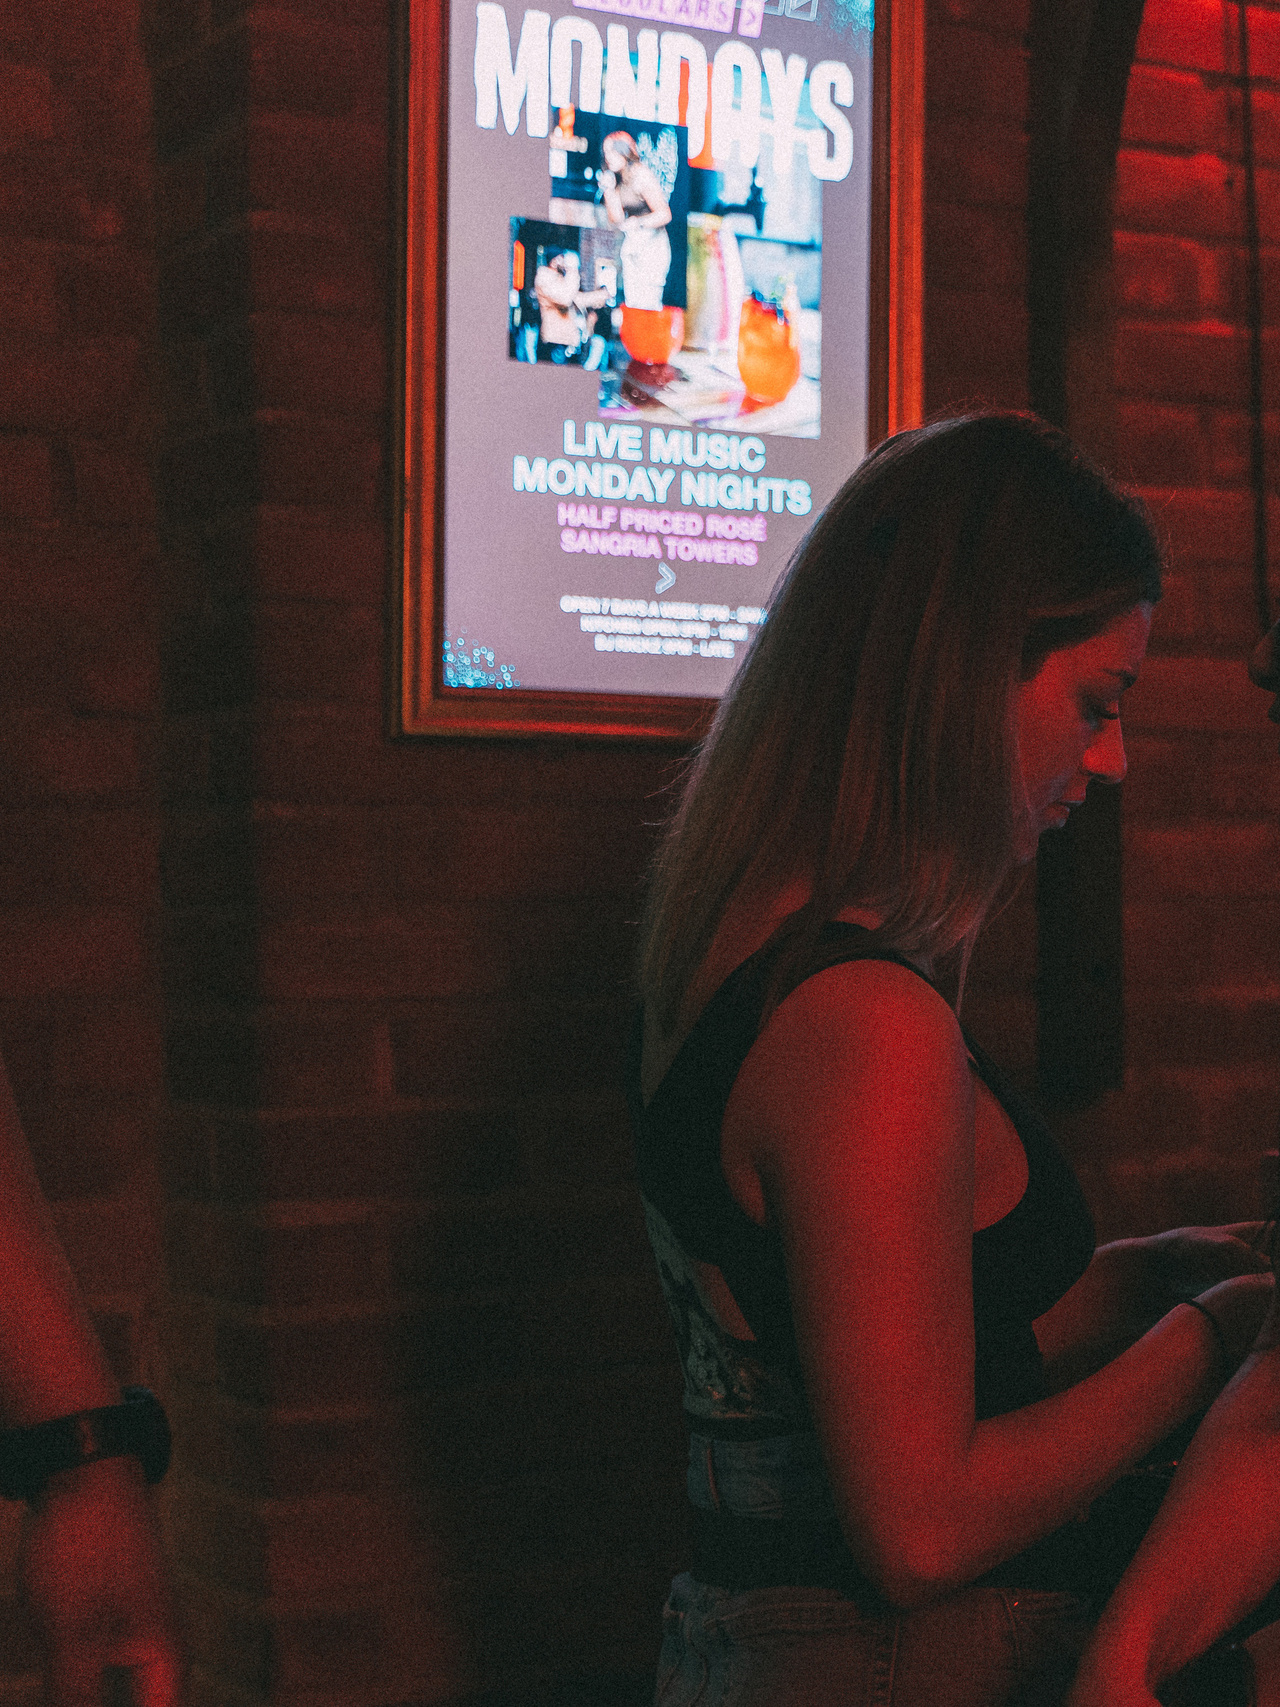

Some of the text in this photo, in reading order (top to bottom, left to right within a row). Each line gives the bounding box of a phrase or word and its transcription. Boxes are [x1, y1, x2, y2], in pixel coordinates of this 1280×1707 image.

[474, 1, 854, 182] MONDAYS
[563, 419, 766, 473] LIVE MUSIC
[513, 455, 812, 516] MONDAY NIGHTS
[557, 502, 618, 530] HALF
[619, 507, 704, 537] PRICED
[560, 527, 759, 567] SANGRIA TOWERS
